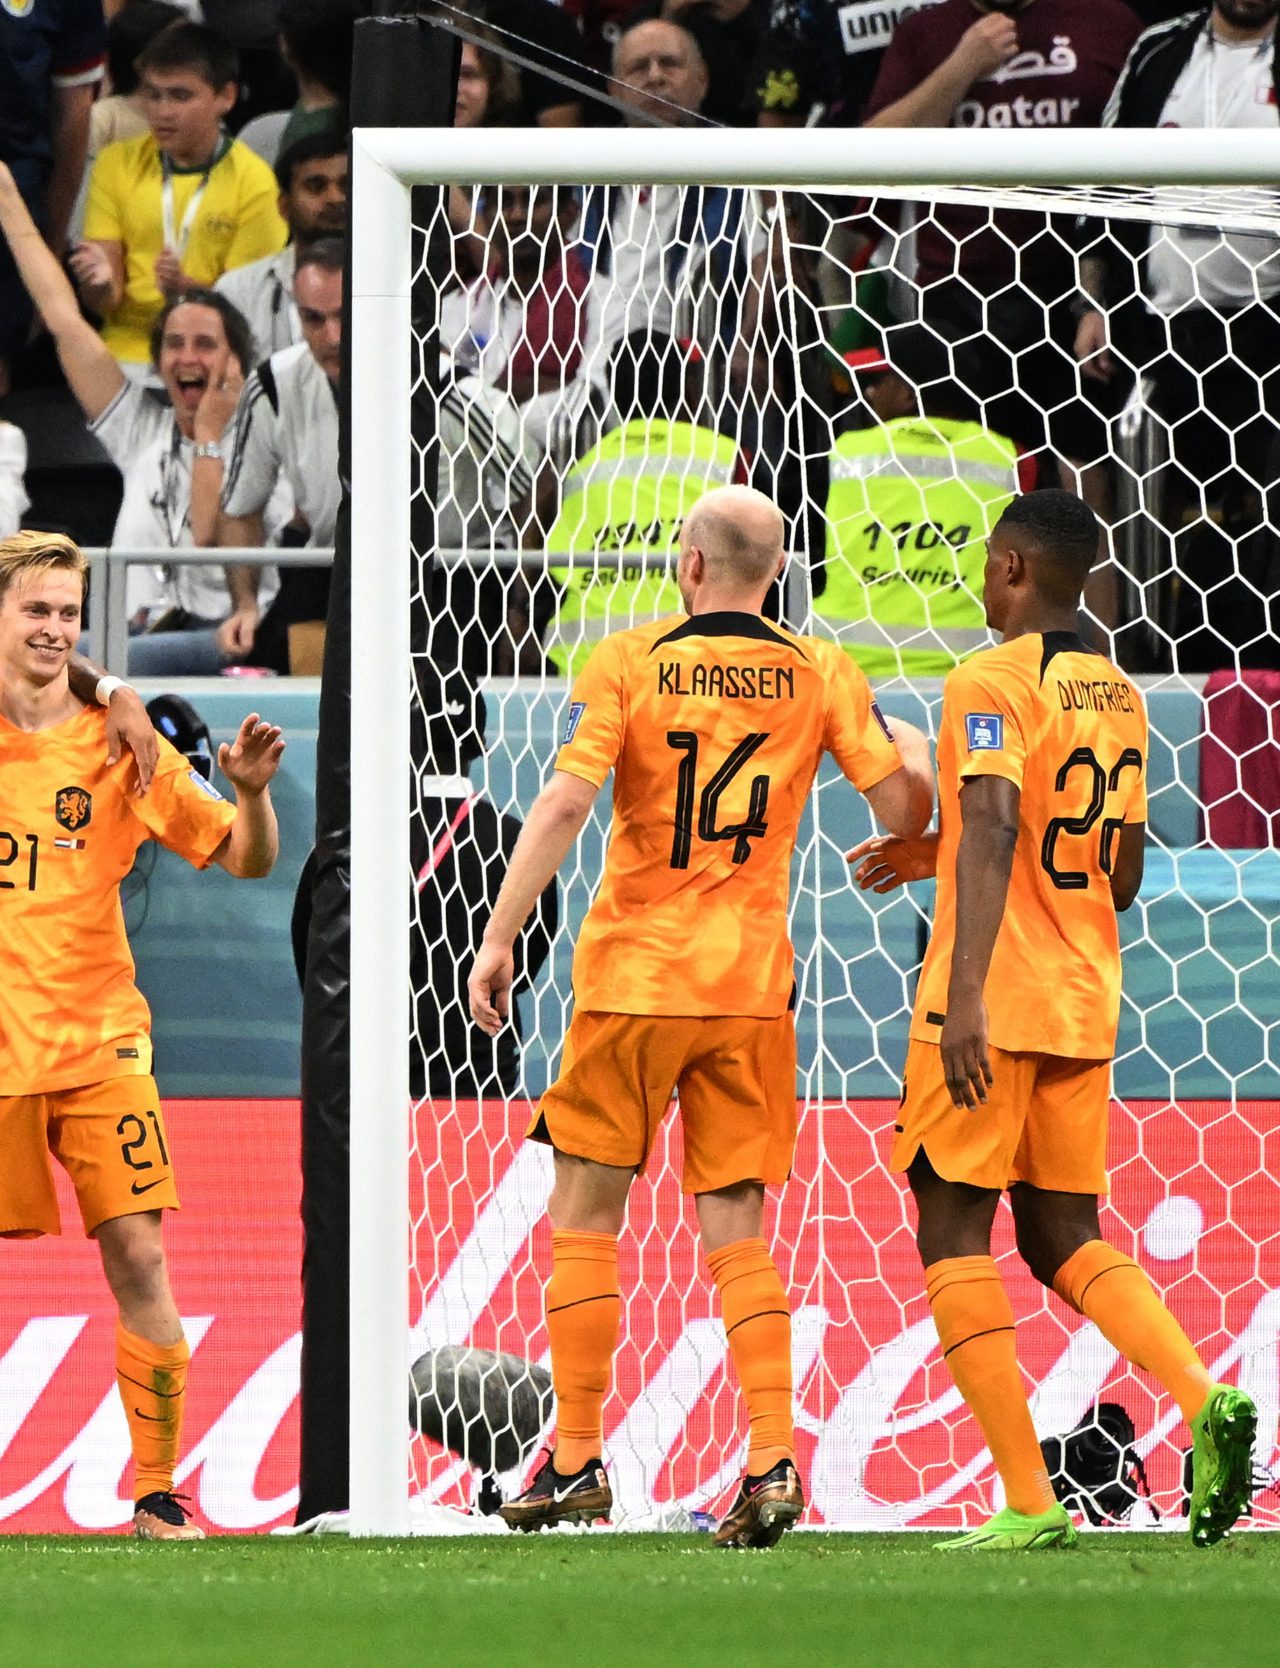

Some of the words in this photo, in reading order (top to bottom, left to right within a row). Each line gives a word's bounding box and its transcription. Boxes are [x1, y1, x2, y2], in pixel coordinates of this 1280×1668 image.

[847, 4, 936, 39] uni
[957, 95, 1080, 129] Qatar
[863, 520, 972, 553] 1104
[861, 566, 967, 594] Security
[658, 662, 795, 699] KLAASSEN
[1057, 680, 1135, 713] DUMFRIES
[666, 731, 771, 870] 14
[116, 1110, 169, 1171] 21
